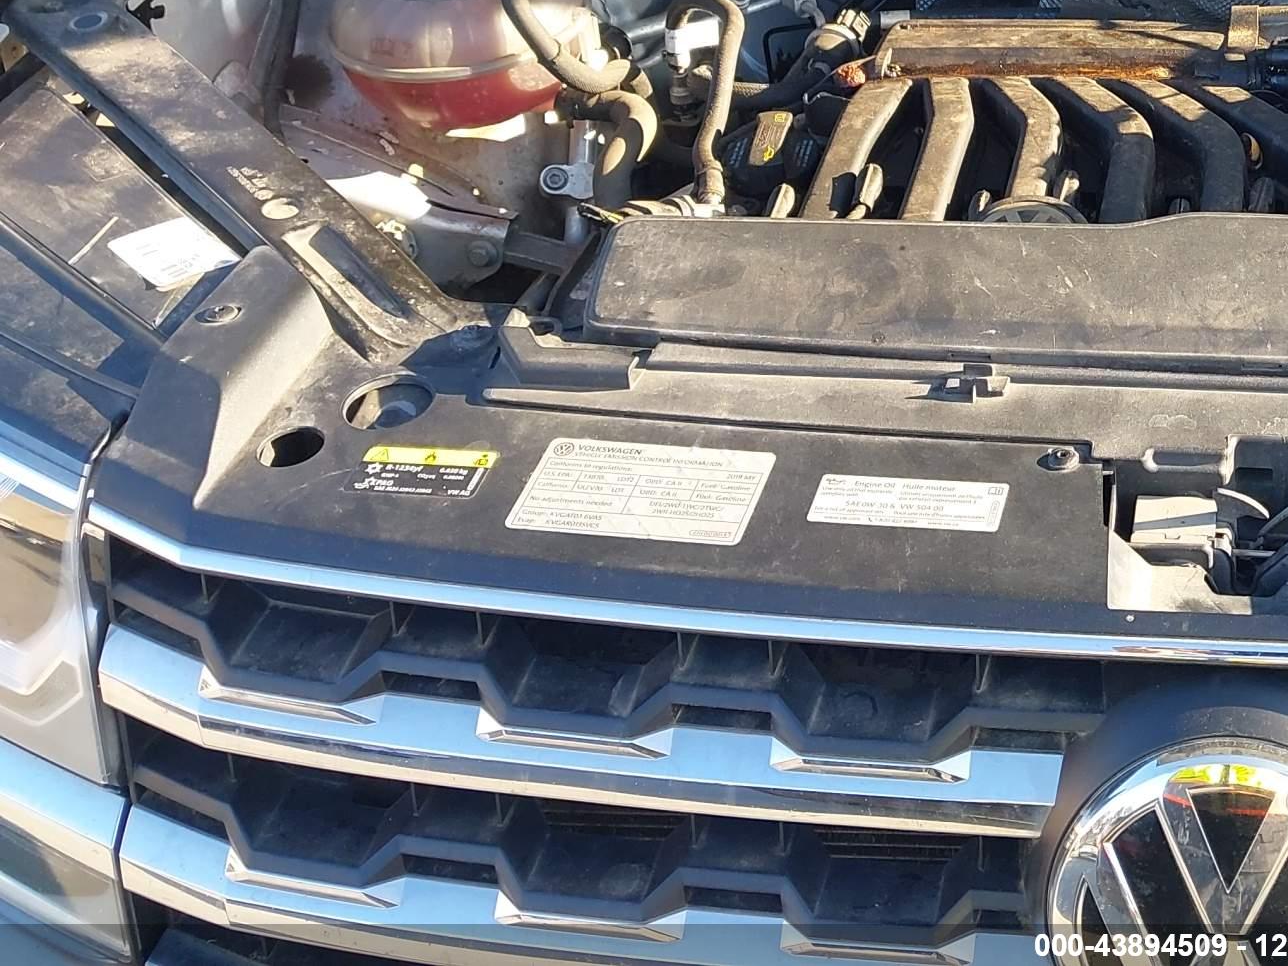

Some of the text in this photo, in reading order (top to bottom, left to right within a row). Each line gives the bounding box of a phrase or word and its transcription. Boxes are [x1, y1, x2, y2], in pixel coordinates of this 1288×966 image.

[578, 444, 642, 455] VOLKSWAGEN
[673, 458, 723, 467] INFORMATION
[854, 480, 882, 489] Engine
